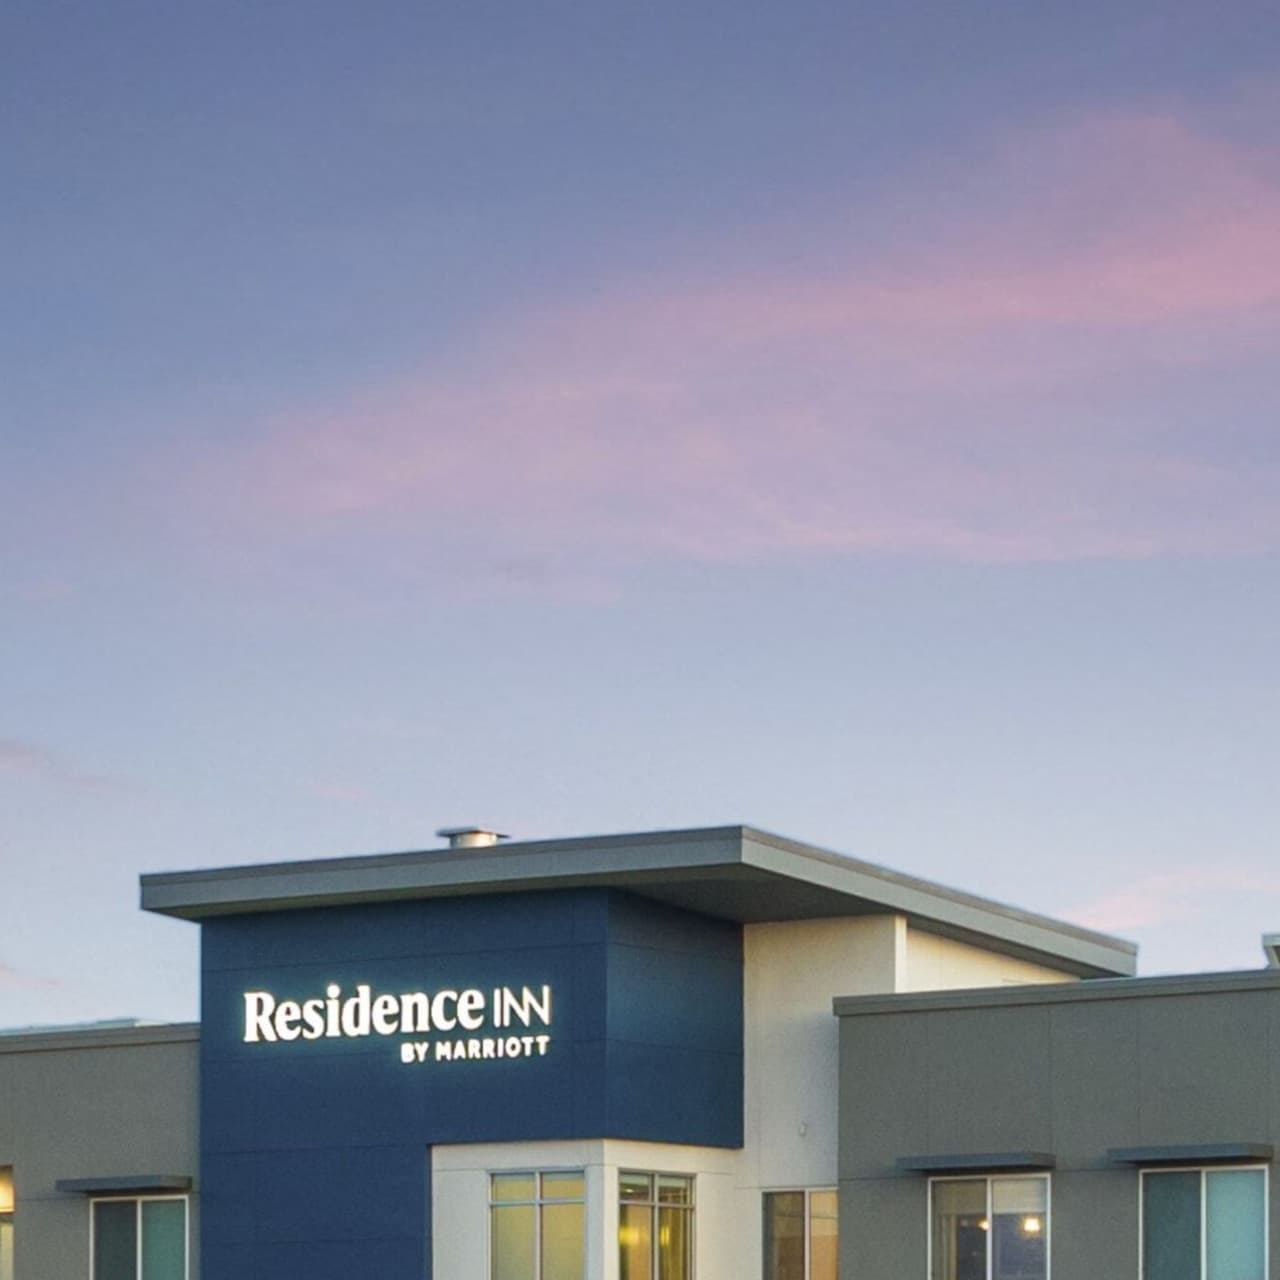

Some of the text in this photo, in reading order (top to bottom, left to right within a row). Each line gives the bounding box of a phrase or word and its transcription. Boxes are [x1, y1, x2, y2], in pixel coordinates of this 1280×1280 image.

[243, 982, 550, 1042] Residence INN
[401, 1036, 550, 1063] BY MARRIOTT
